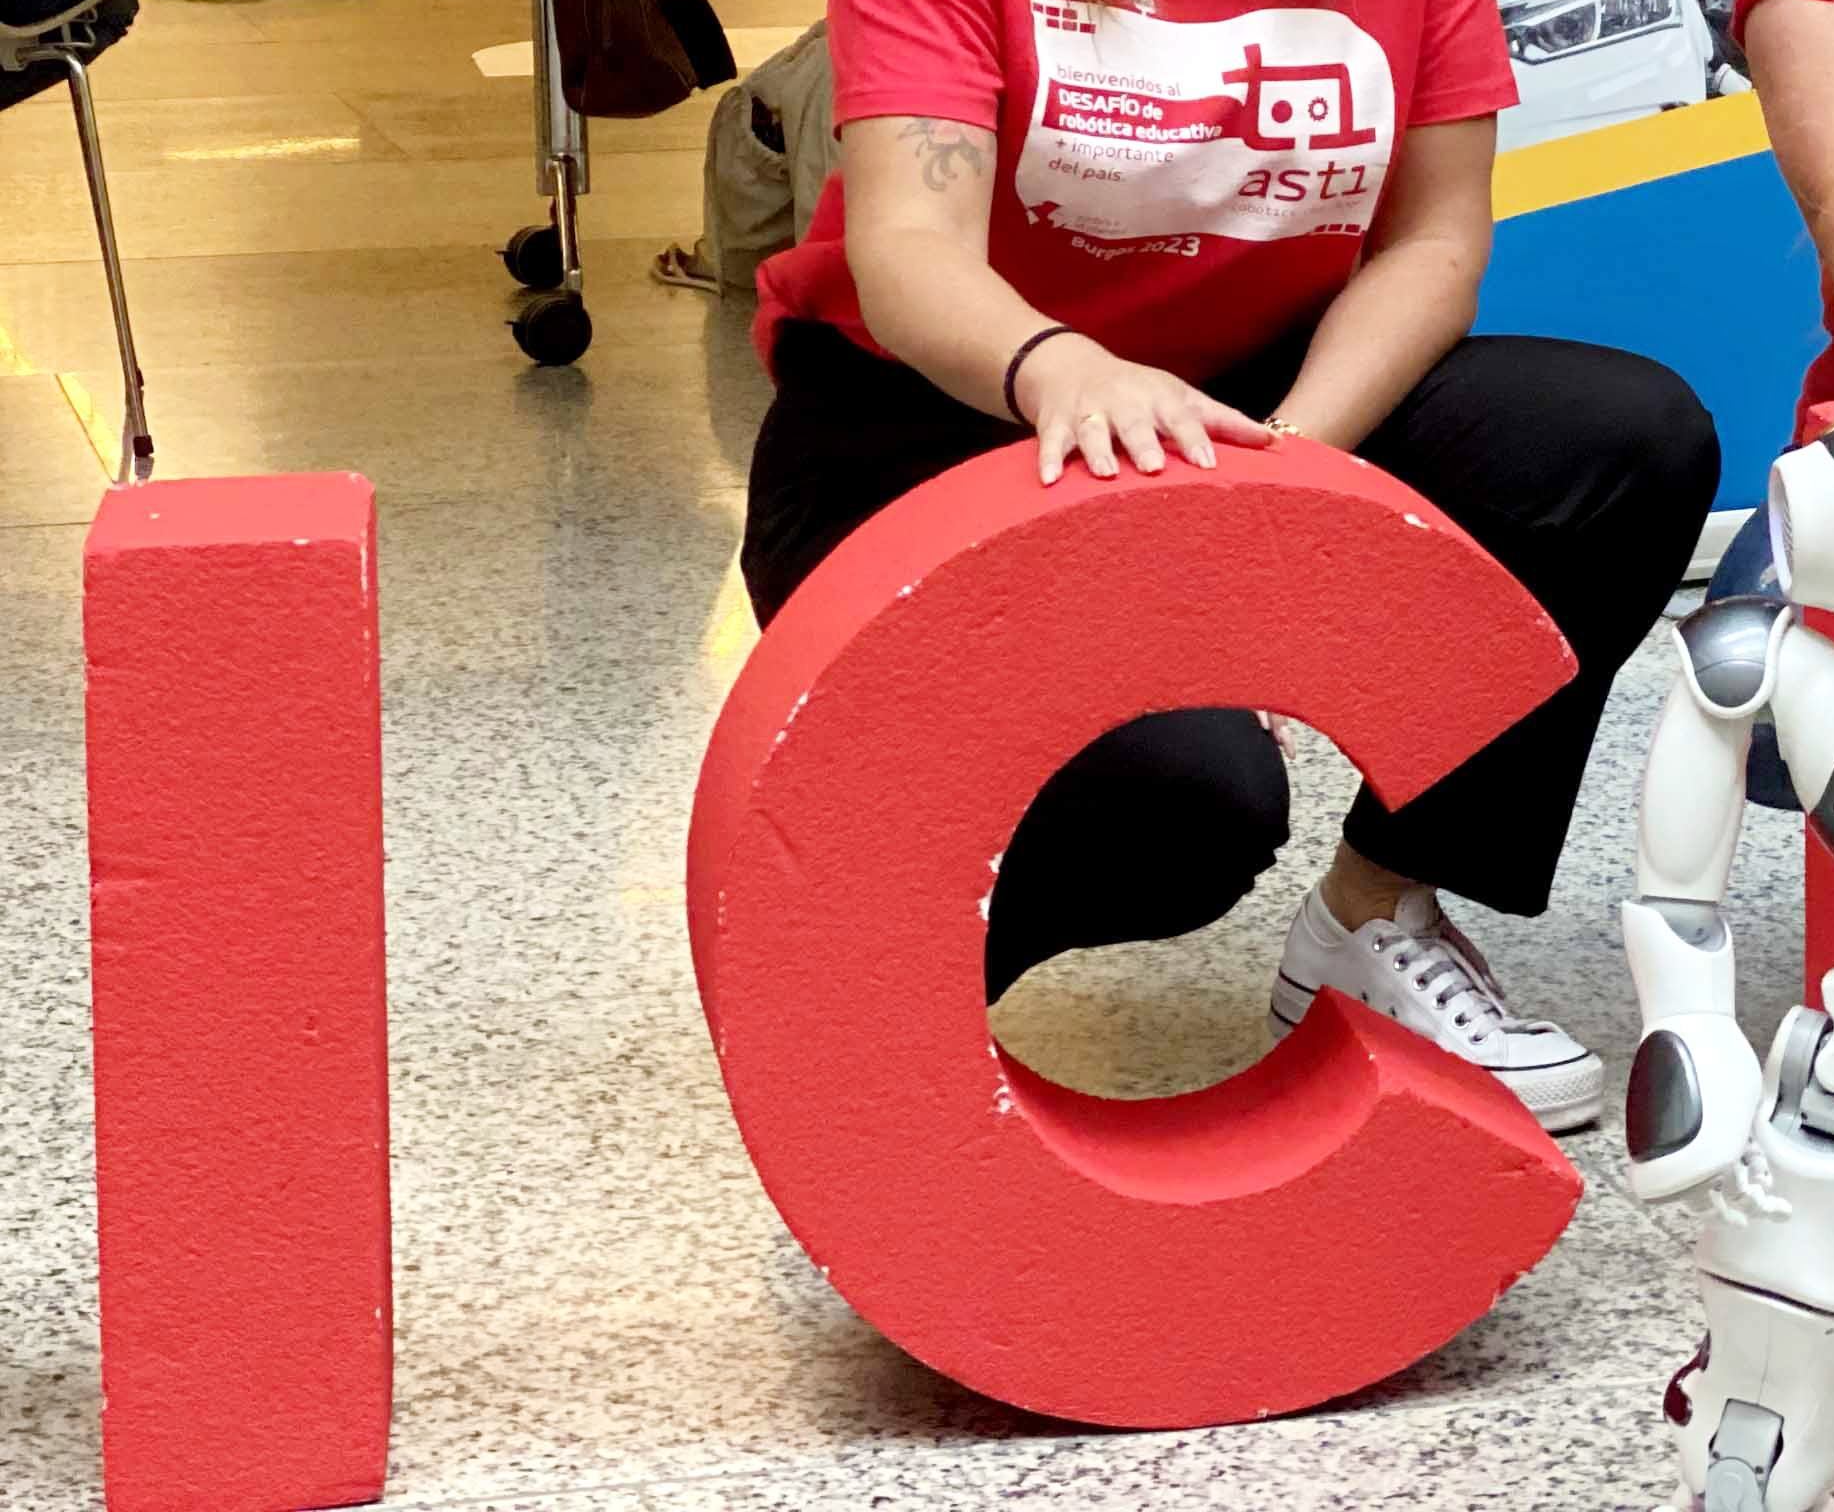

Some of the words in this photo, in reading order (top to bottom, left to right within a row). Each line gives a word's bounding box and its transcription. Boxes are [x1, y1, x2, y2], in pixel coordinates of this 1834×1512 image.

[1056, 64, 1163, 96] bienvenidos
[1167, 81, 1182, 97] al
[1058, 88, 1141, 117] DESAFÍO
[1142, 101, 1164, 121] de
[1058, 112, 1135, 138] robótica
[1048, 157, 1080, 175] del
[1071, 141, 1175, 165] importante
[1238, 160, 1369, 202] asti
[1137, 235, 1201, 258] 2023
